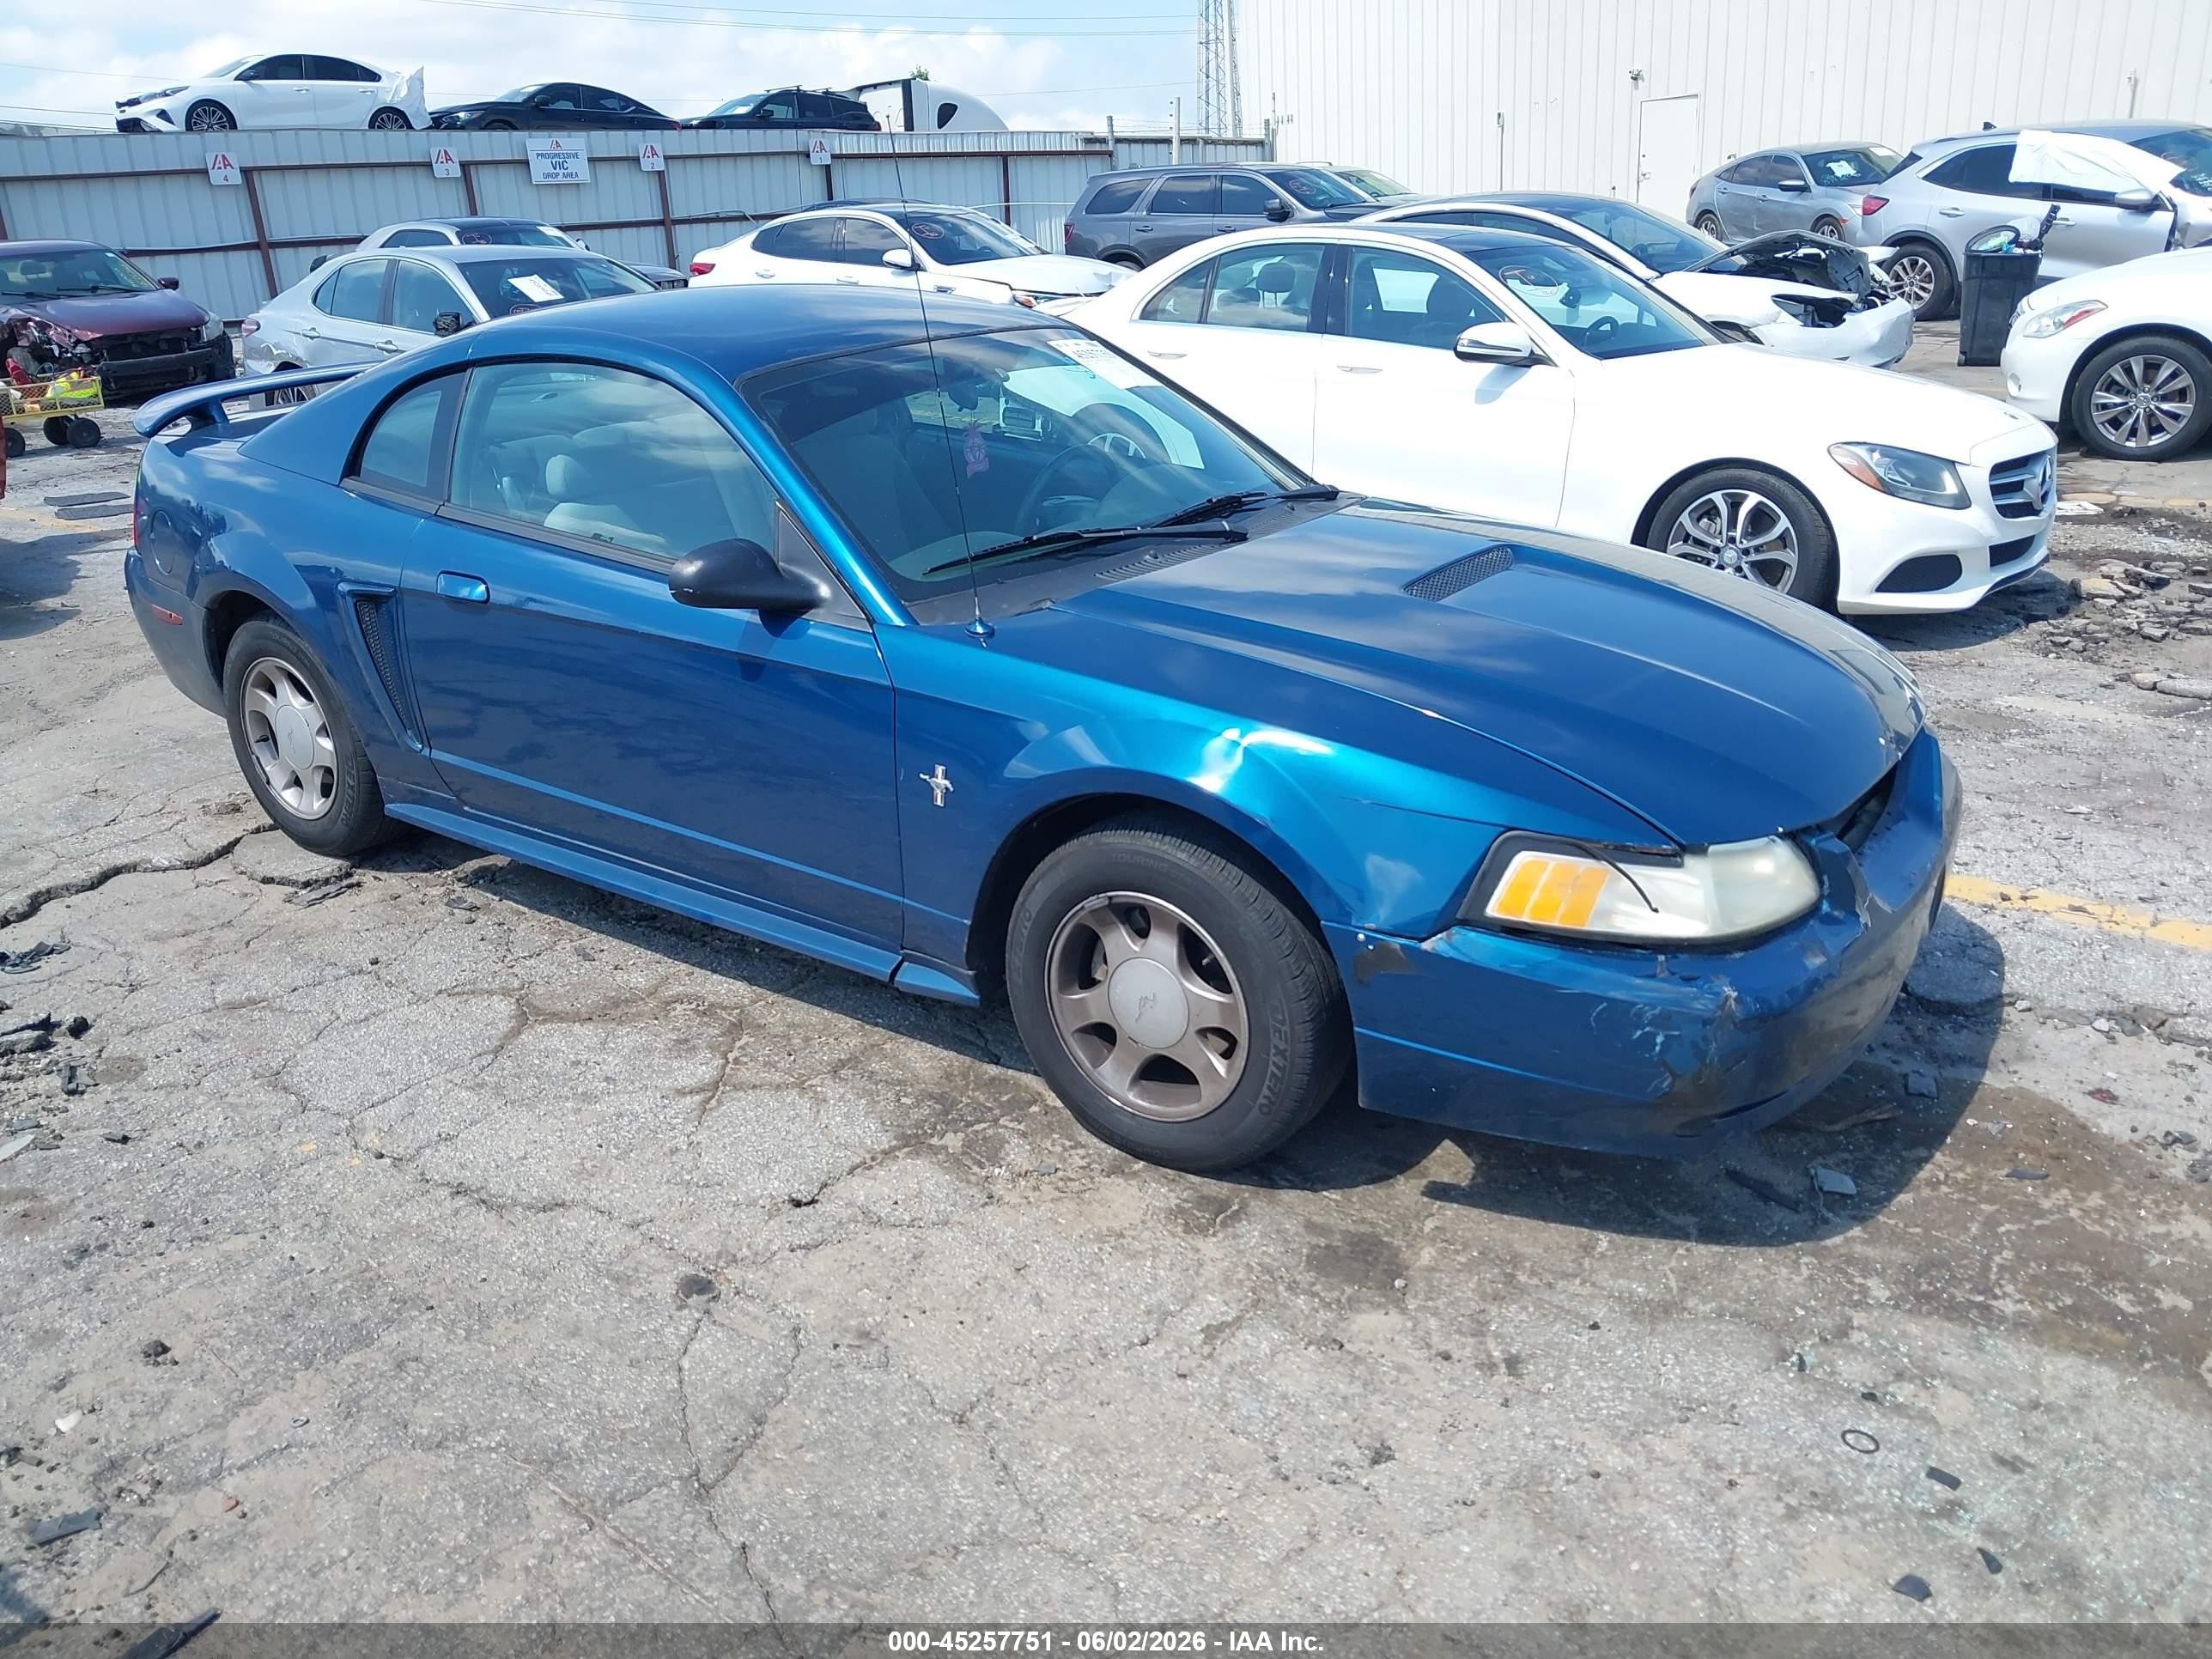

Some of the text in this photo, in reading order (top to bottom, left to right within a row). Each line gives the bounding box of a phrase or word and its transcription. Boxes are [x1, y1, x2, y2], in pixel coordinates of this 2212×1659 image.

[550, 160, 569, 171] VIC
[1110, 852, 1169, 872] TOURING
[1257, 998, 1290, 1115] DEXTERO
